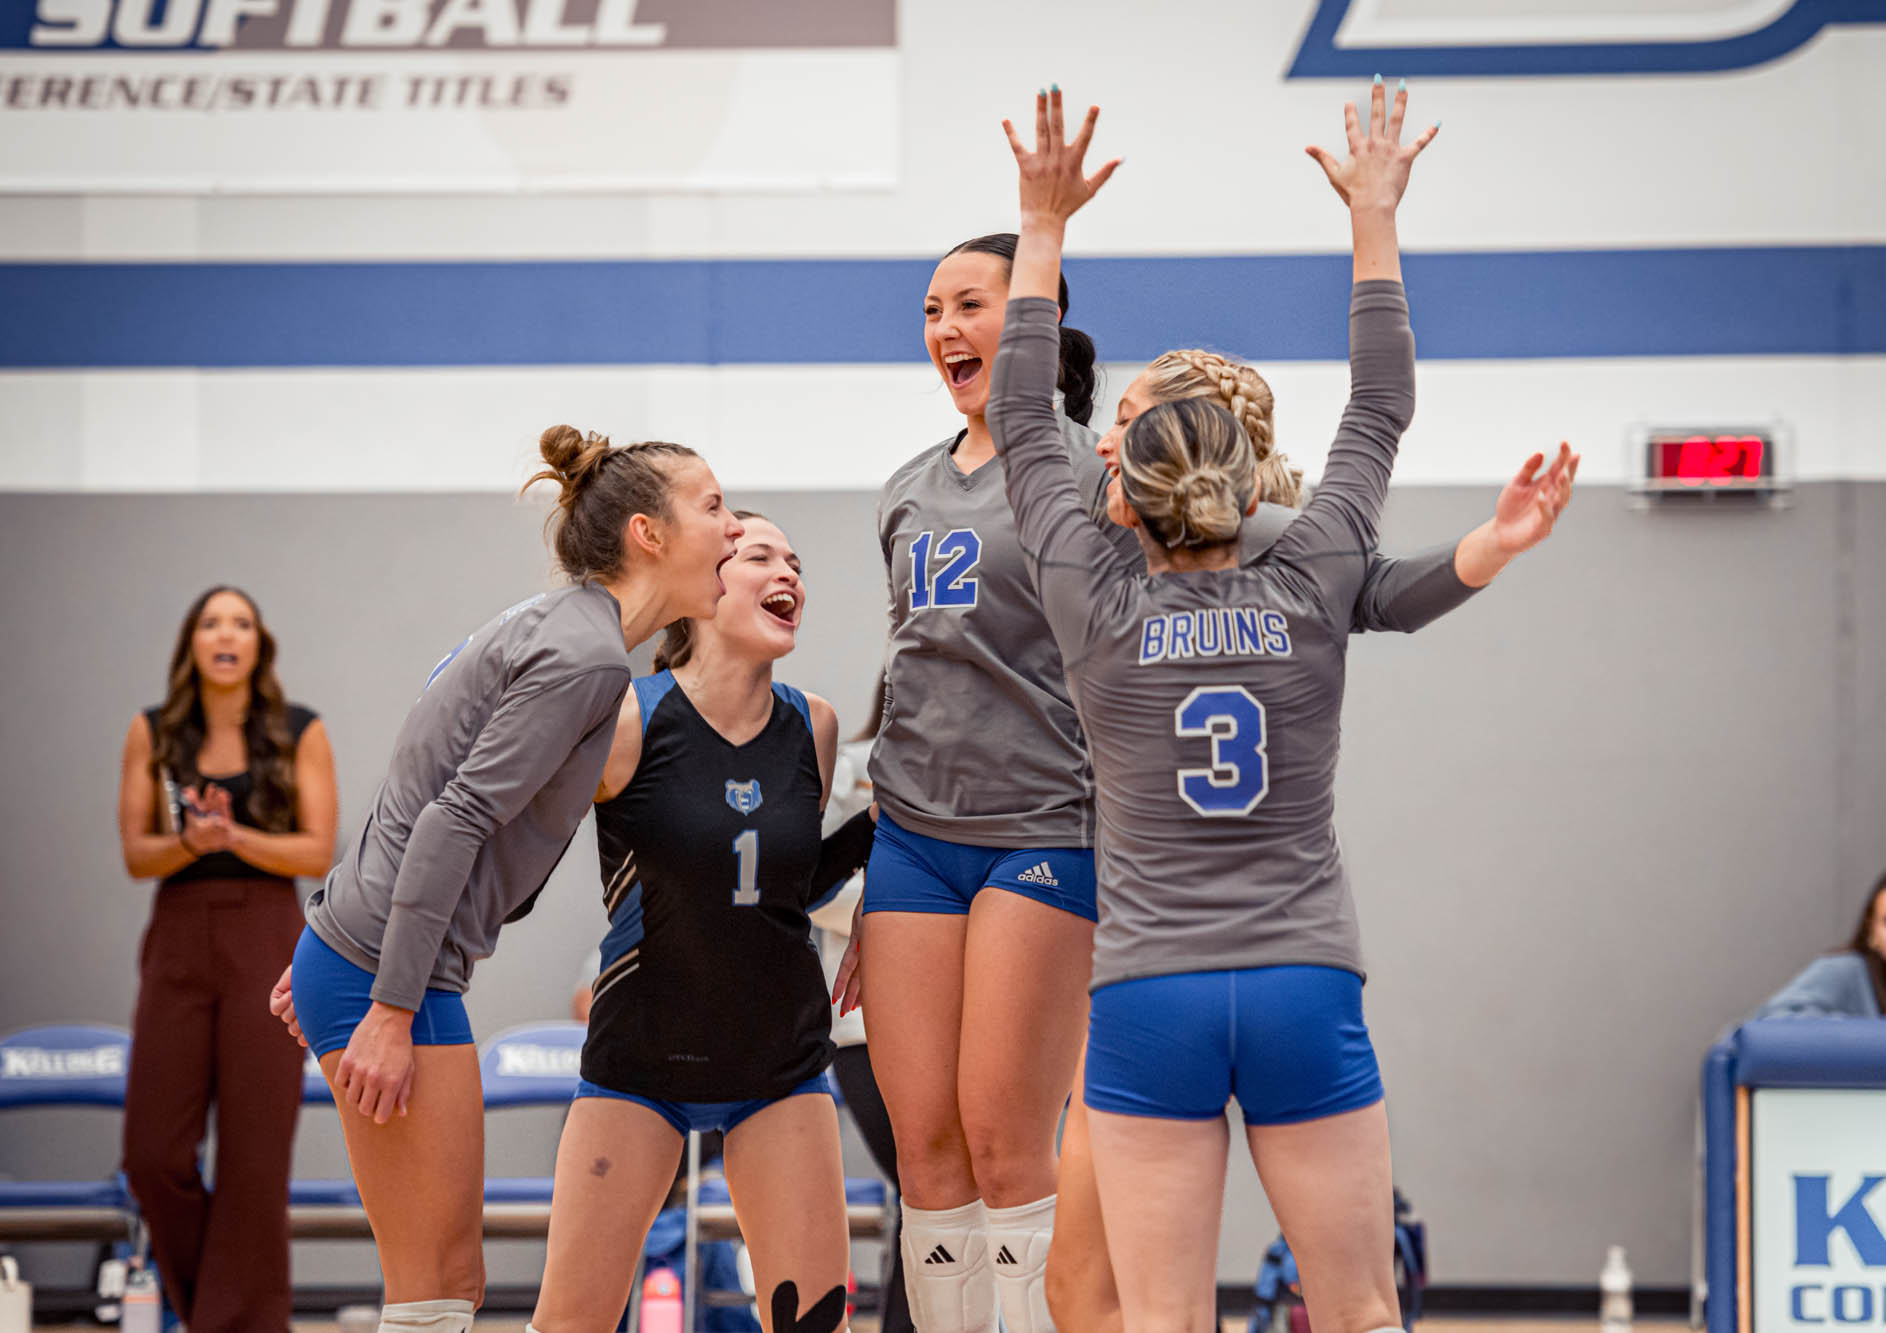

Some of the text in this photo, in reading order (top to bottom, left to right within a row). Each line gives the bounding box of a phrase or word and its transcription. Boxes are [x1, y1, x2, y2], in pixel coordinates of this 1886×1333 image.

[0, 75, 574, 111] ERENCE/STATE TITLES
[908, 528, 982, 611] 12
[1139, 607, 1292, 665] BRUINS
[1175, 685, 1269, 817] 3
[732, 829, 761, 906] 1
[1017, 873, 1059, 886] adidas
[1792, 1175, 1886, 1267] K
[1791, 1284, 1886, 1324] CO
